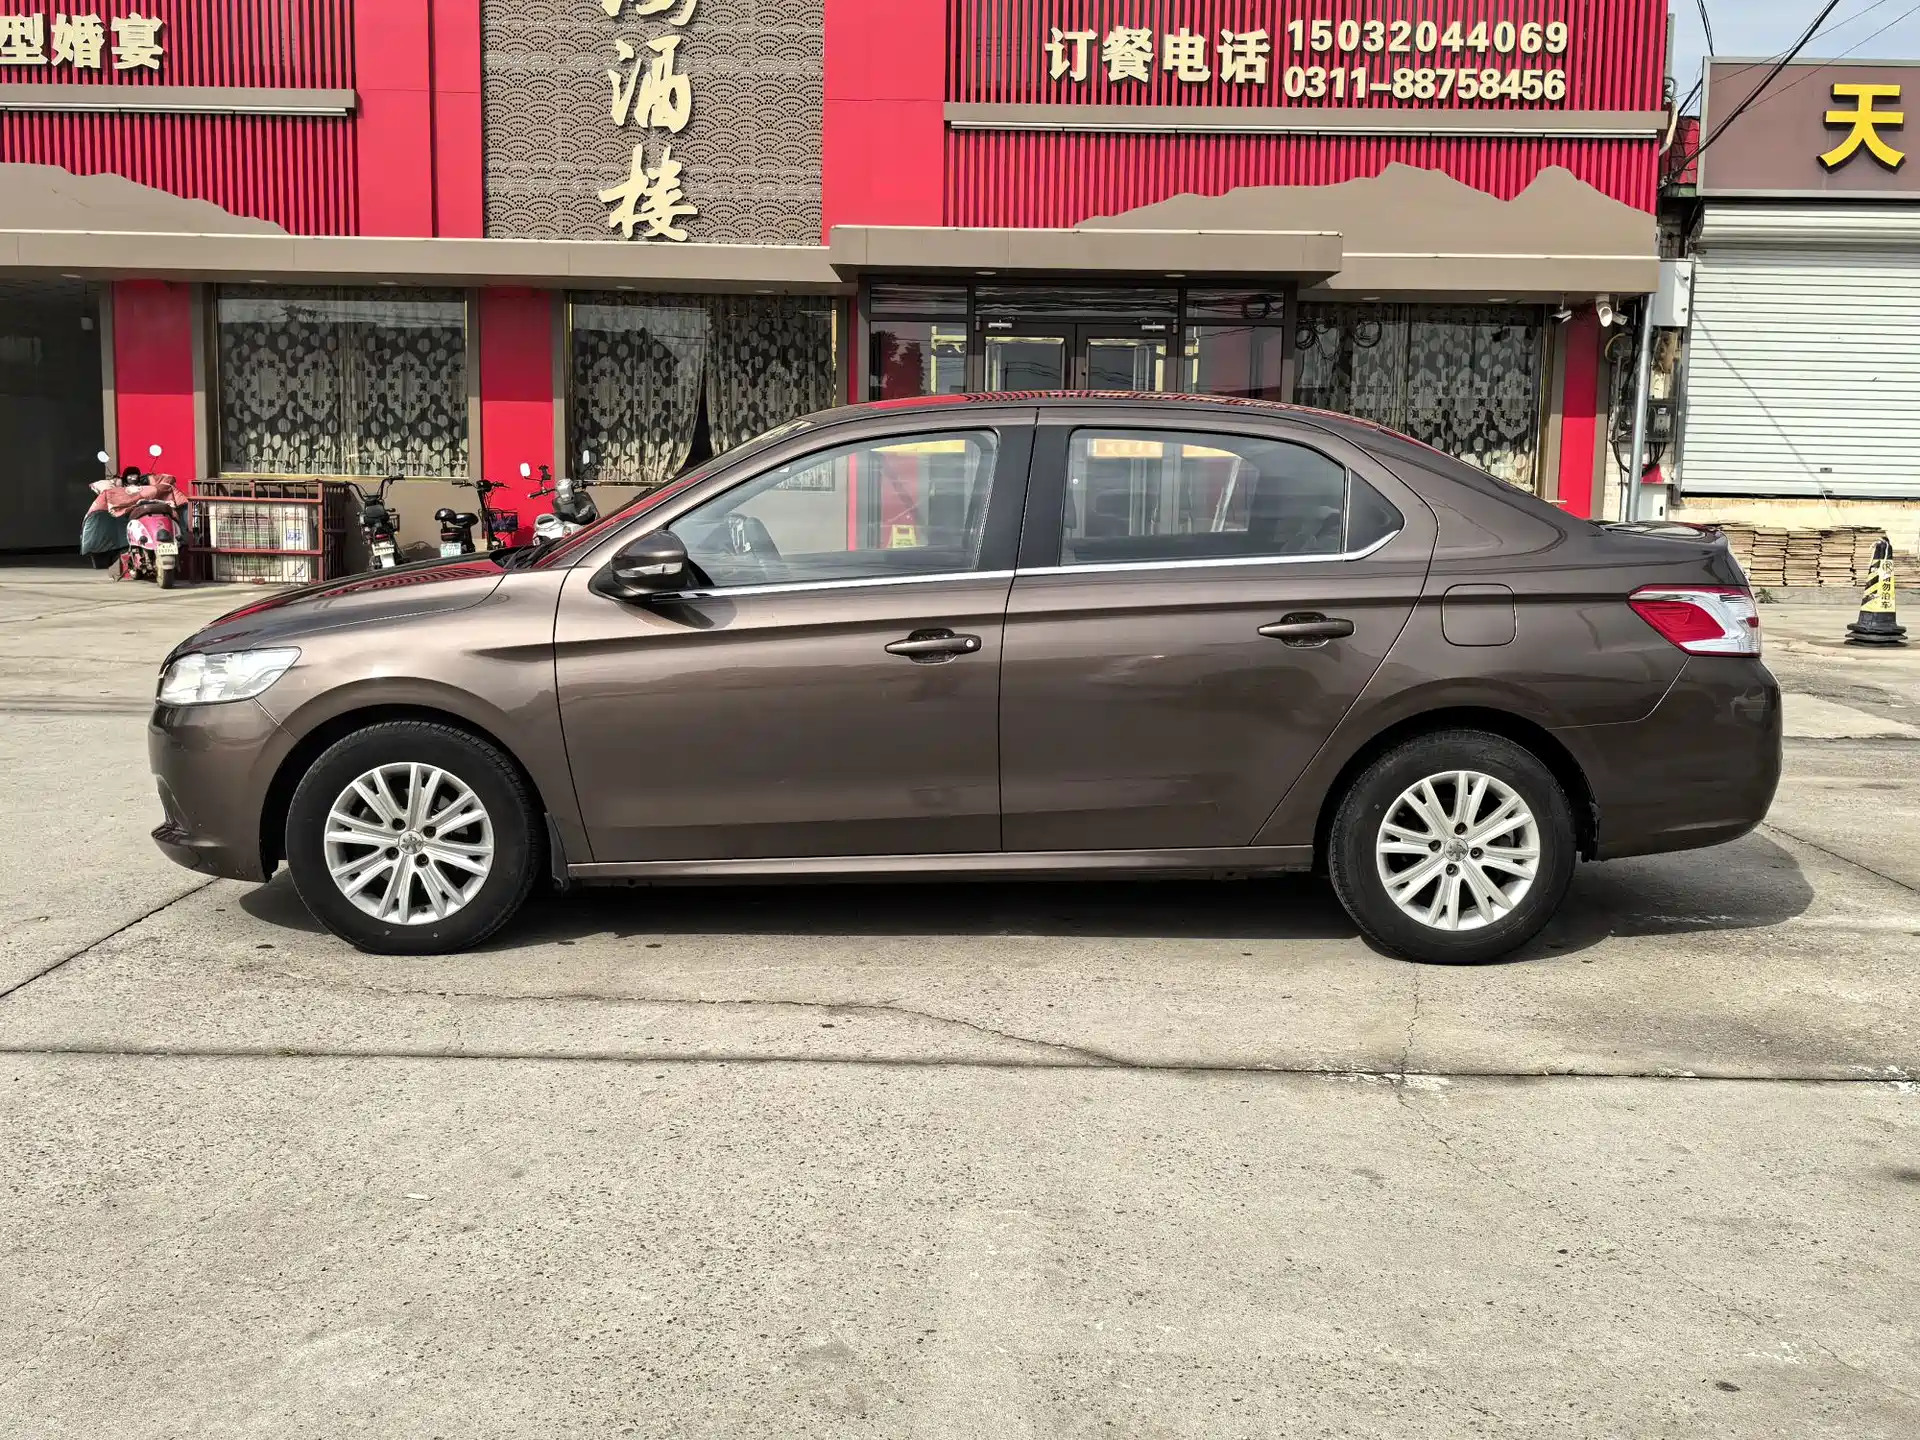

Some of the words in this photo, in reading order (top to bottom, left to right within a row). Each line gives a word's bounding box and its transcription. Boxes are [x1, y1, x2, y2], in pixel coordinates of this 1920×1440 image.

[0, 12, 164, 70] 型婚宴
[1045, 25, 1271, 84] 订餐电话
[1287, 19, 1568, 54] 15032044069
[1283, 65, 1567, 101] 0311-88758456
[599, 0, 698, 242] 酒楼
[1822, 83, 1906, 170] 天
